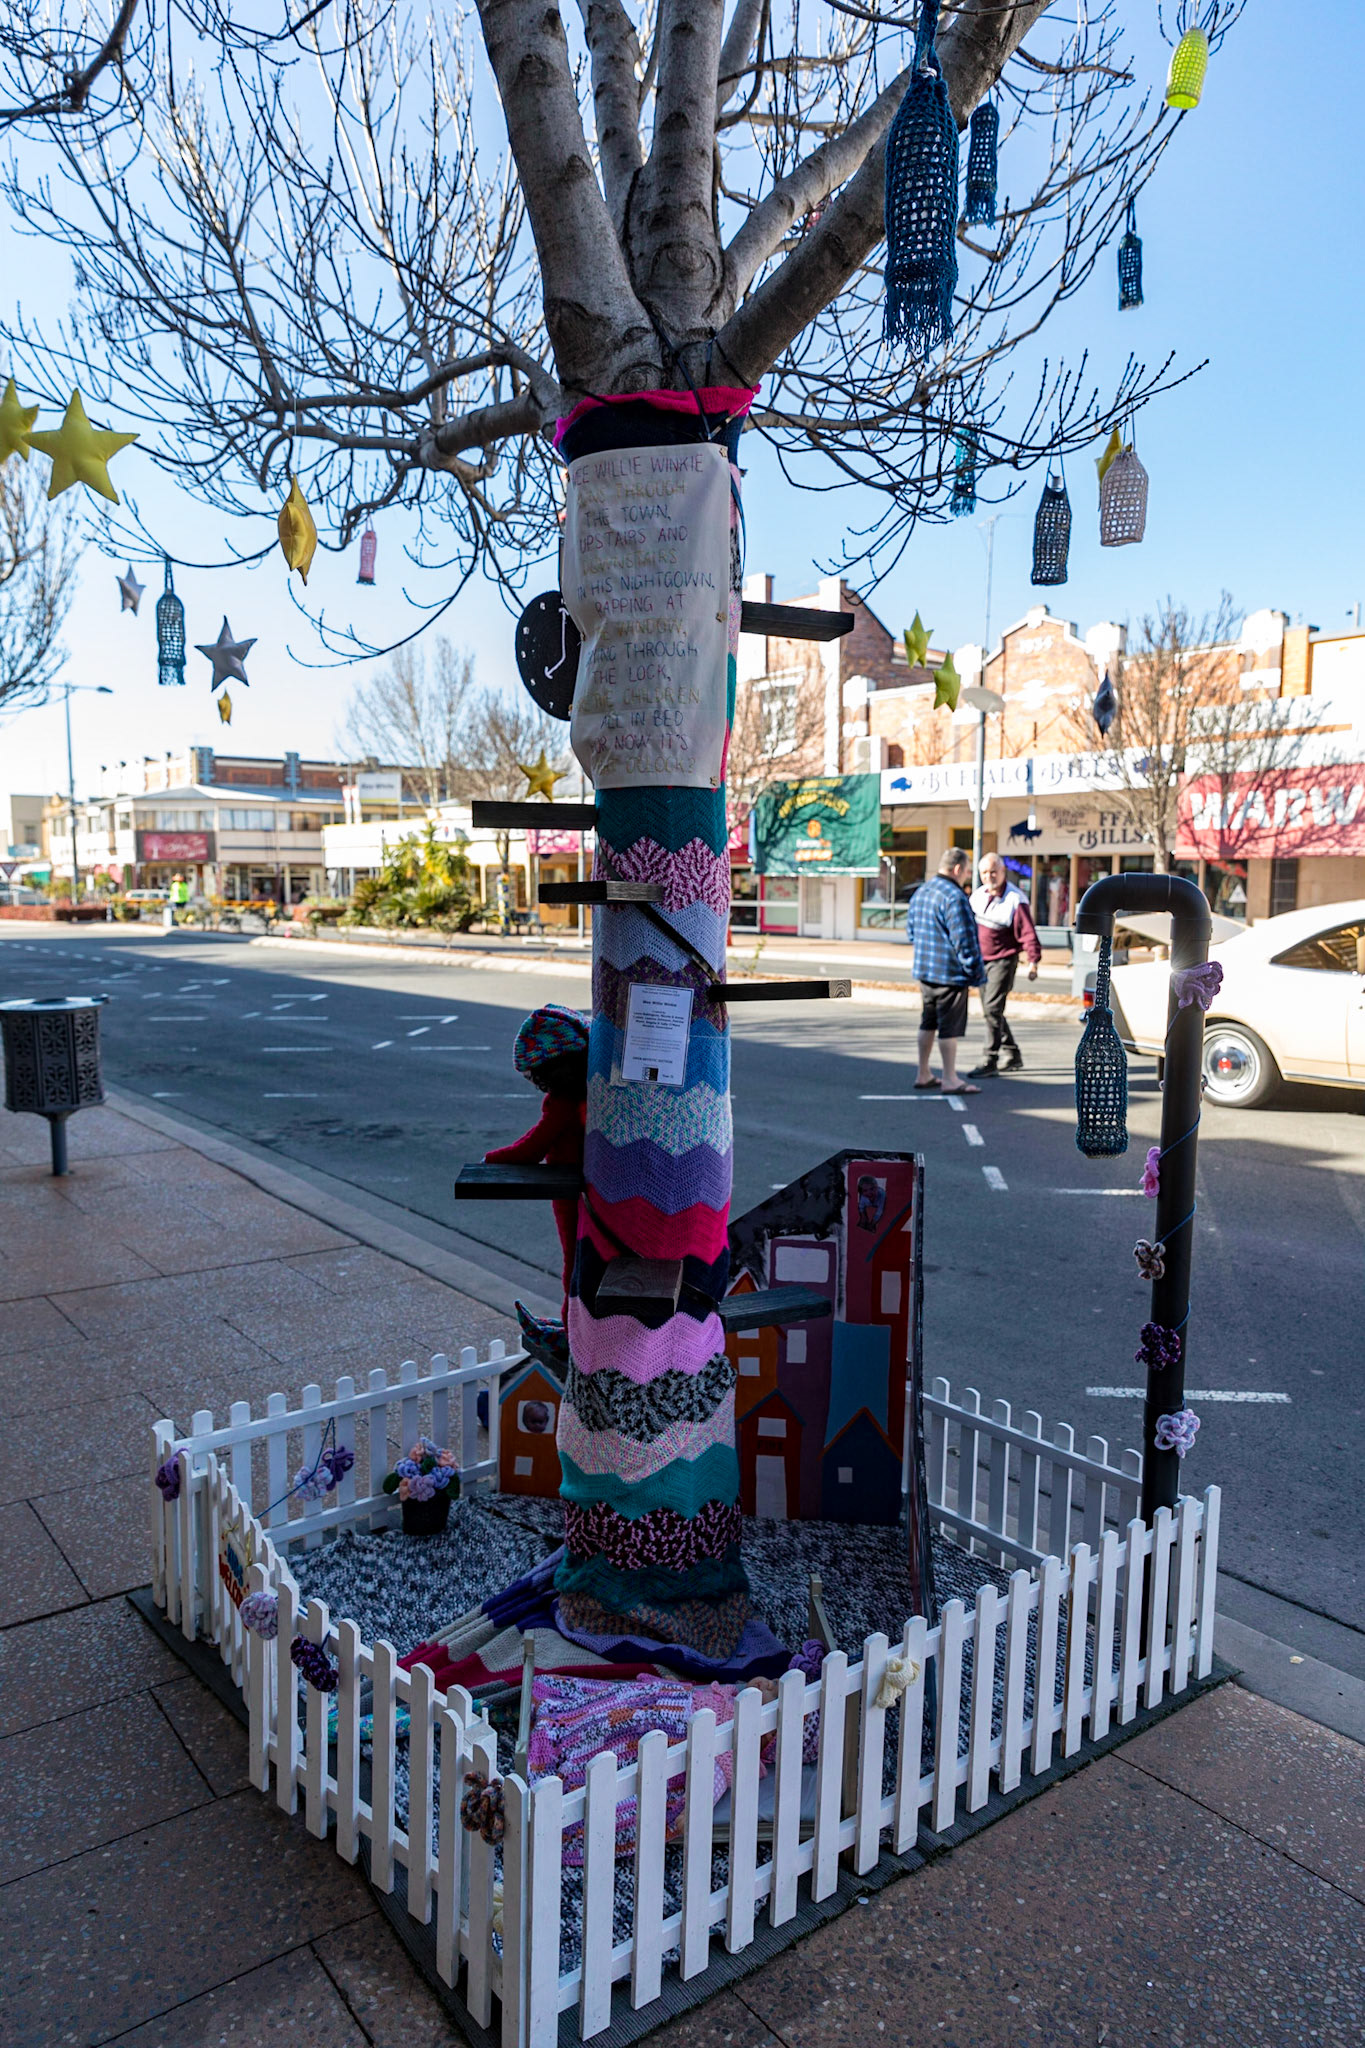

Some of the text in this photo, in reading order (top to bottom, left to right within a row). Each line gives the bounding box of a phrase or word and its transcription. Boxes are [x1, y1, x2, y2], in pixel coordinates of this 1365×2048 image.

[594, 455, 642, 479] WILLIE
[650, 454, 704, 474] WINKIE
[615, 480, 685, 500] THROUGH
[584, 508, 610, 528] THE
[579, 526, 688, 554] UPSTAIRS AND
[591, 578, 614, 595] HIS
[595, 594, 687, 618] RAPPING AT
[624, 640, 698, 658] THROUGH
[592, 664, 672, 684] THE LOCK,
[624, 688, 701, 706] CHILDREN
[600, 710, 684, 730] ALL IN BED
[614, 734, 648, 752] NOW
